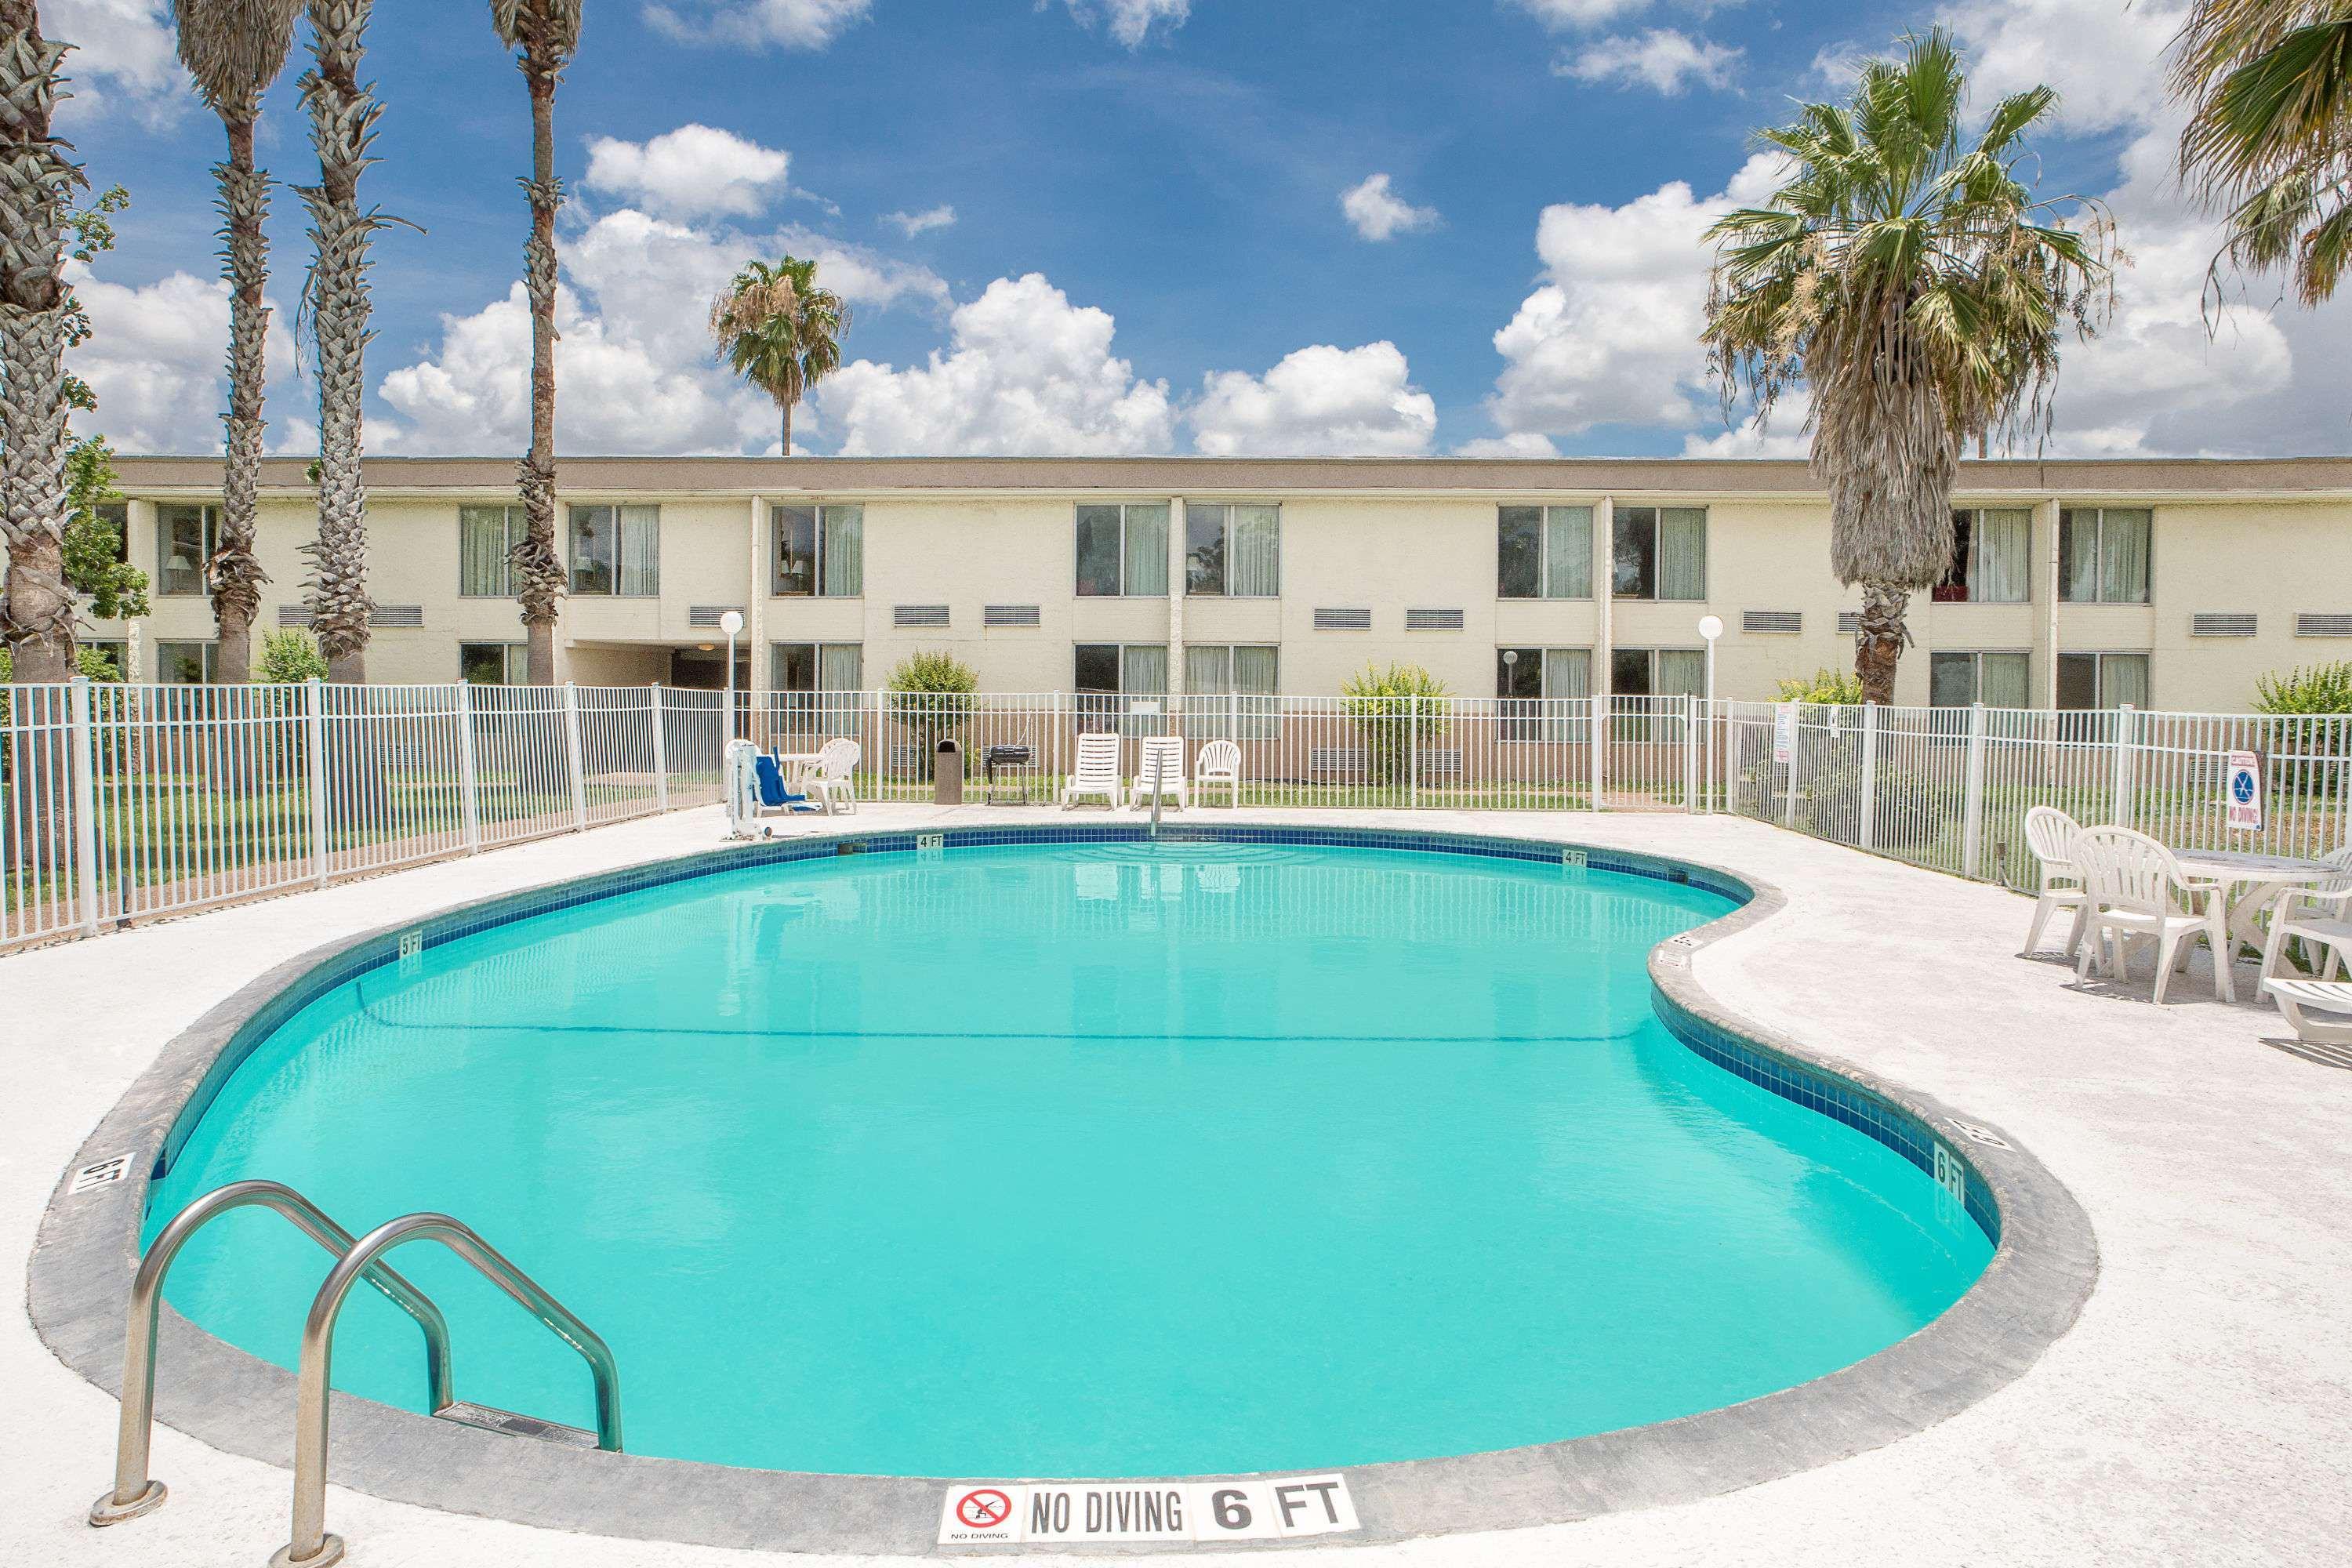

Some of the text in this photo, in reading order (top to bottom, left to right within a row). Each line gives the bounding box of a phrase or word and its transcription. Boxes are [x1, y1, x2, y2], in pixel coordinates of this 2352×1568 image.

[920, 836, 942, 847] 4 FT
[1566, 851, 1585, 865] 4 FT
[402, 933, 421, 955] 5 FT
[76, 1159, 125, 1190] 6 FT
[1938, 1151, 1962, 1202] 6 FT
[1030, 1490, 1183, 1534] NO DIVING
[1211, 1481, 1340, 1530] 6 FT
